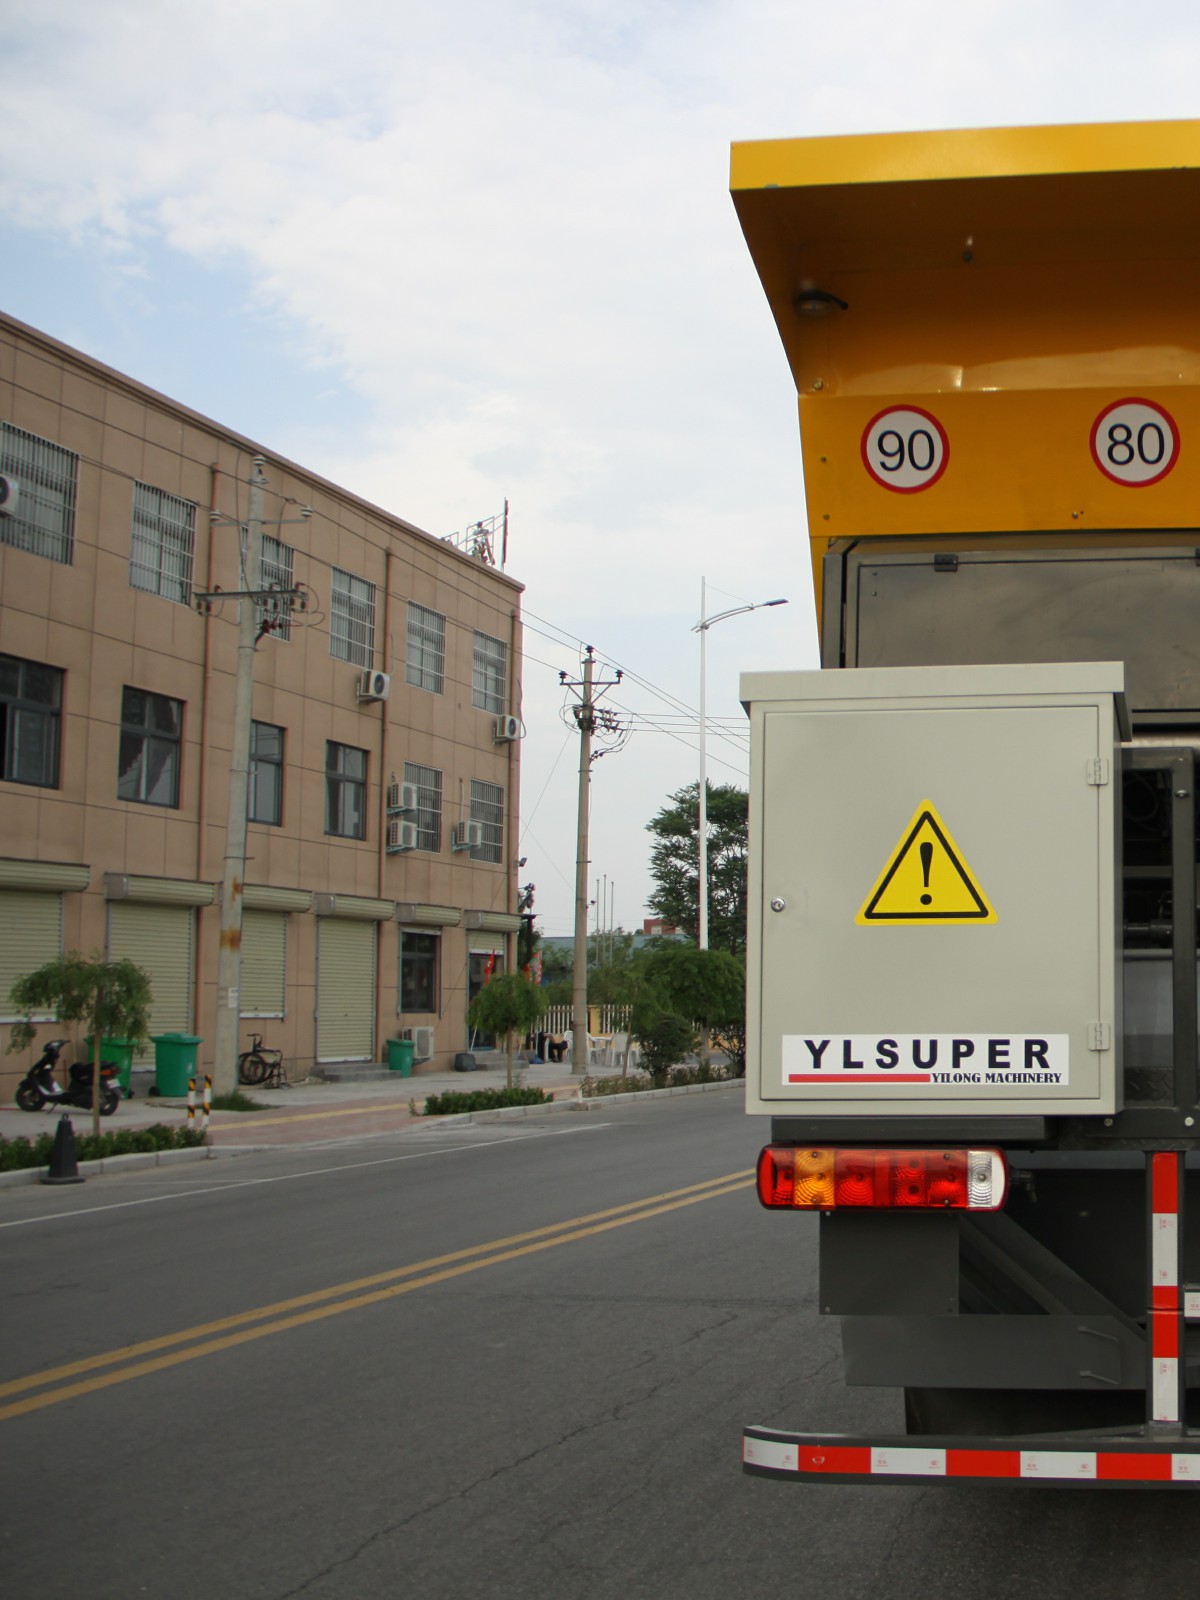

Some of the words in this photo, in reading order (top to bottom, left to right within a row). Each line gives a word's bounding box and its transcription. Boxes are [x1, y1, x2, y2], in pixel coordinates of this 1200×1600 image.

[876, 429, 936, 473] 90
[1106, 422, 1165, 465] 80
[804, 1038, 1051, 1070] YLSUPER
[931, 1072, 981, 1083] YILONG
[985, 1072, 1062, 1083] MACHINERY
